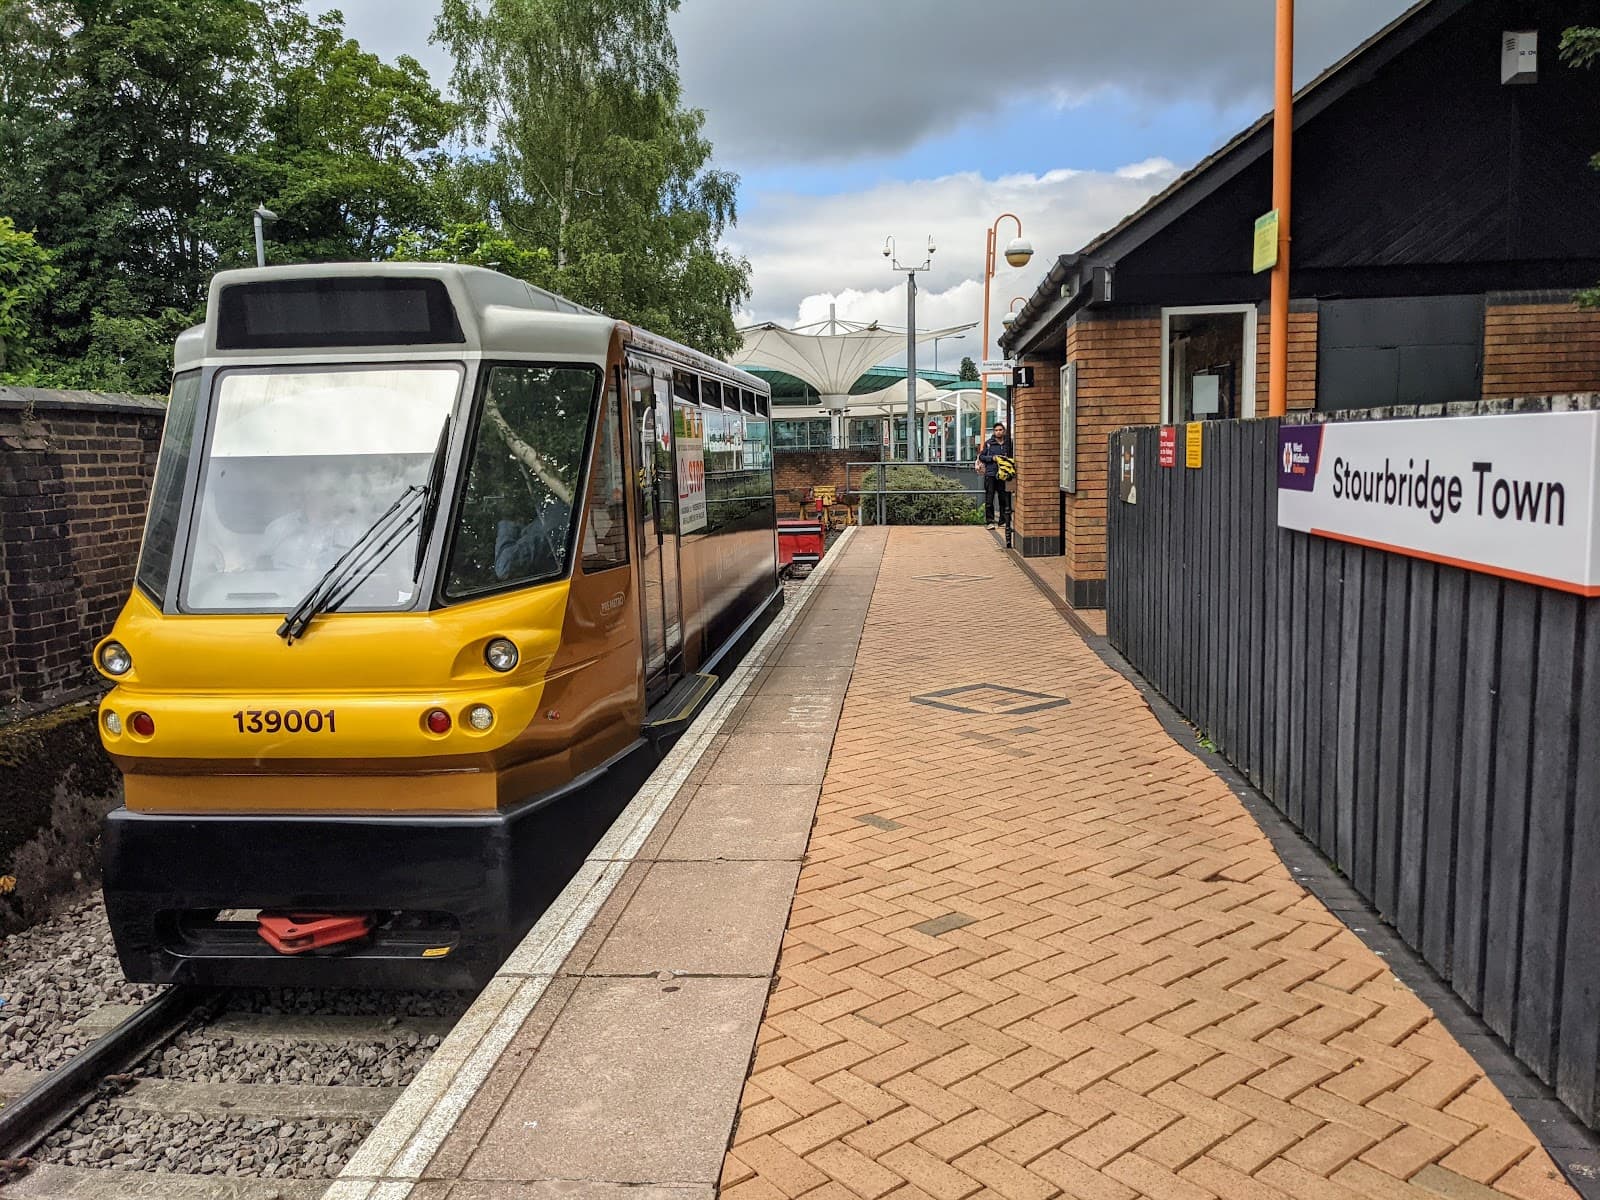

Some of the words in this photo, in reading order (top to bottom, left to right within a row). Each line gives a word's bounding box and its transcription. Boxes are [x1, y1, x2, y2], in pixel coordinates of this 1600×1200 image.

[1017, 367, 1026, 384] 1
[688, 460, 704, 494] STOP
[1332, 456, 1463, 524] Stourbridge
[1472, 461, 1566, 526] Town
[233, 709, 336, 734] 139001
